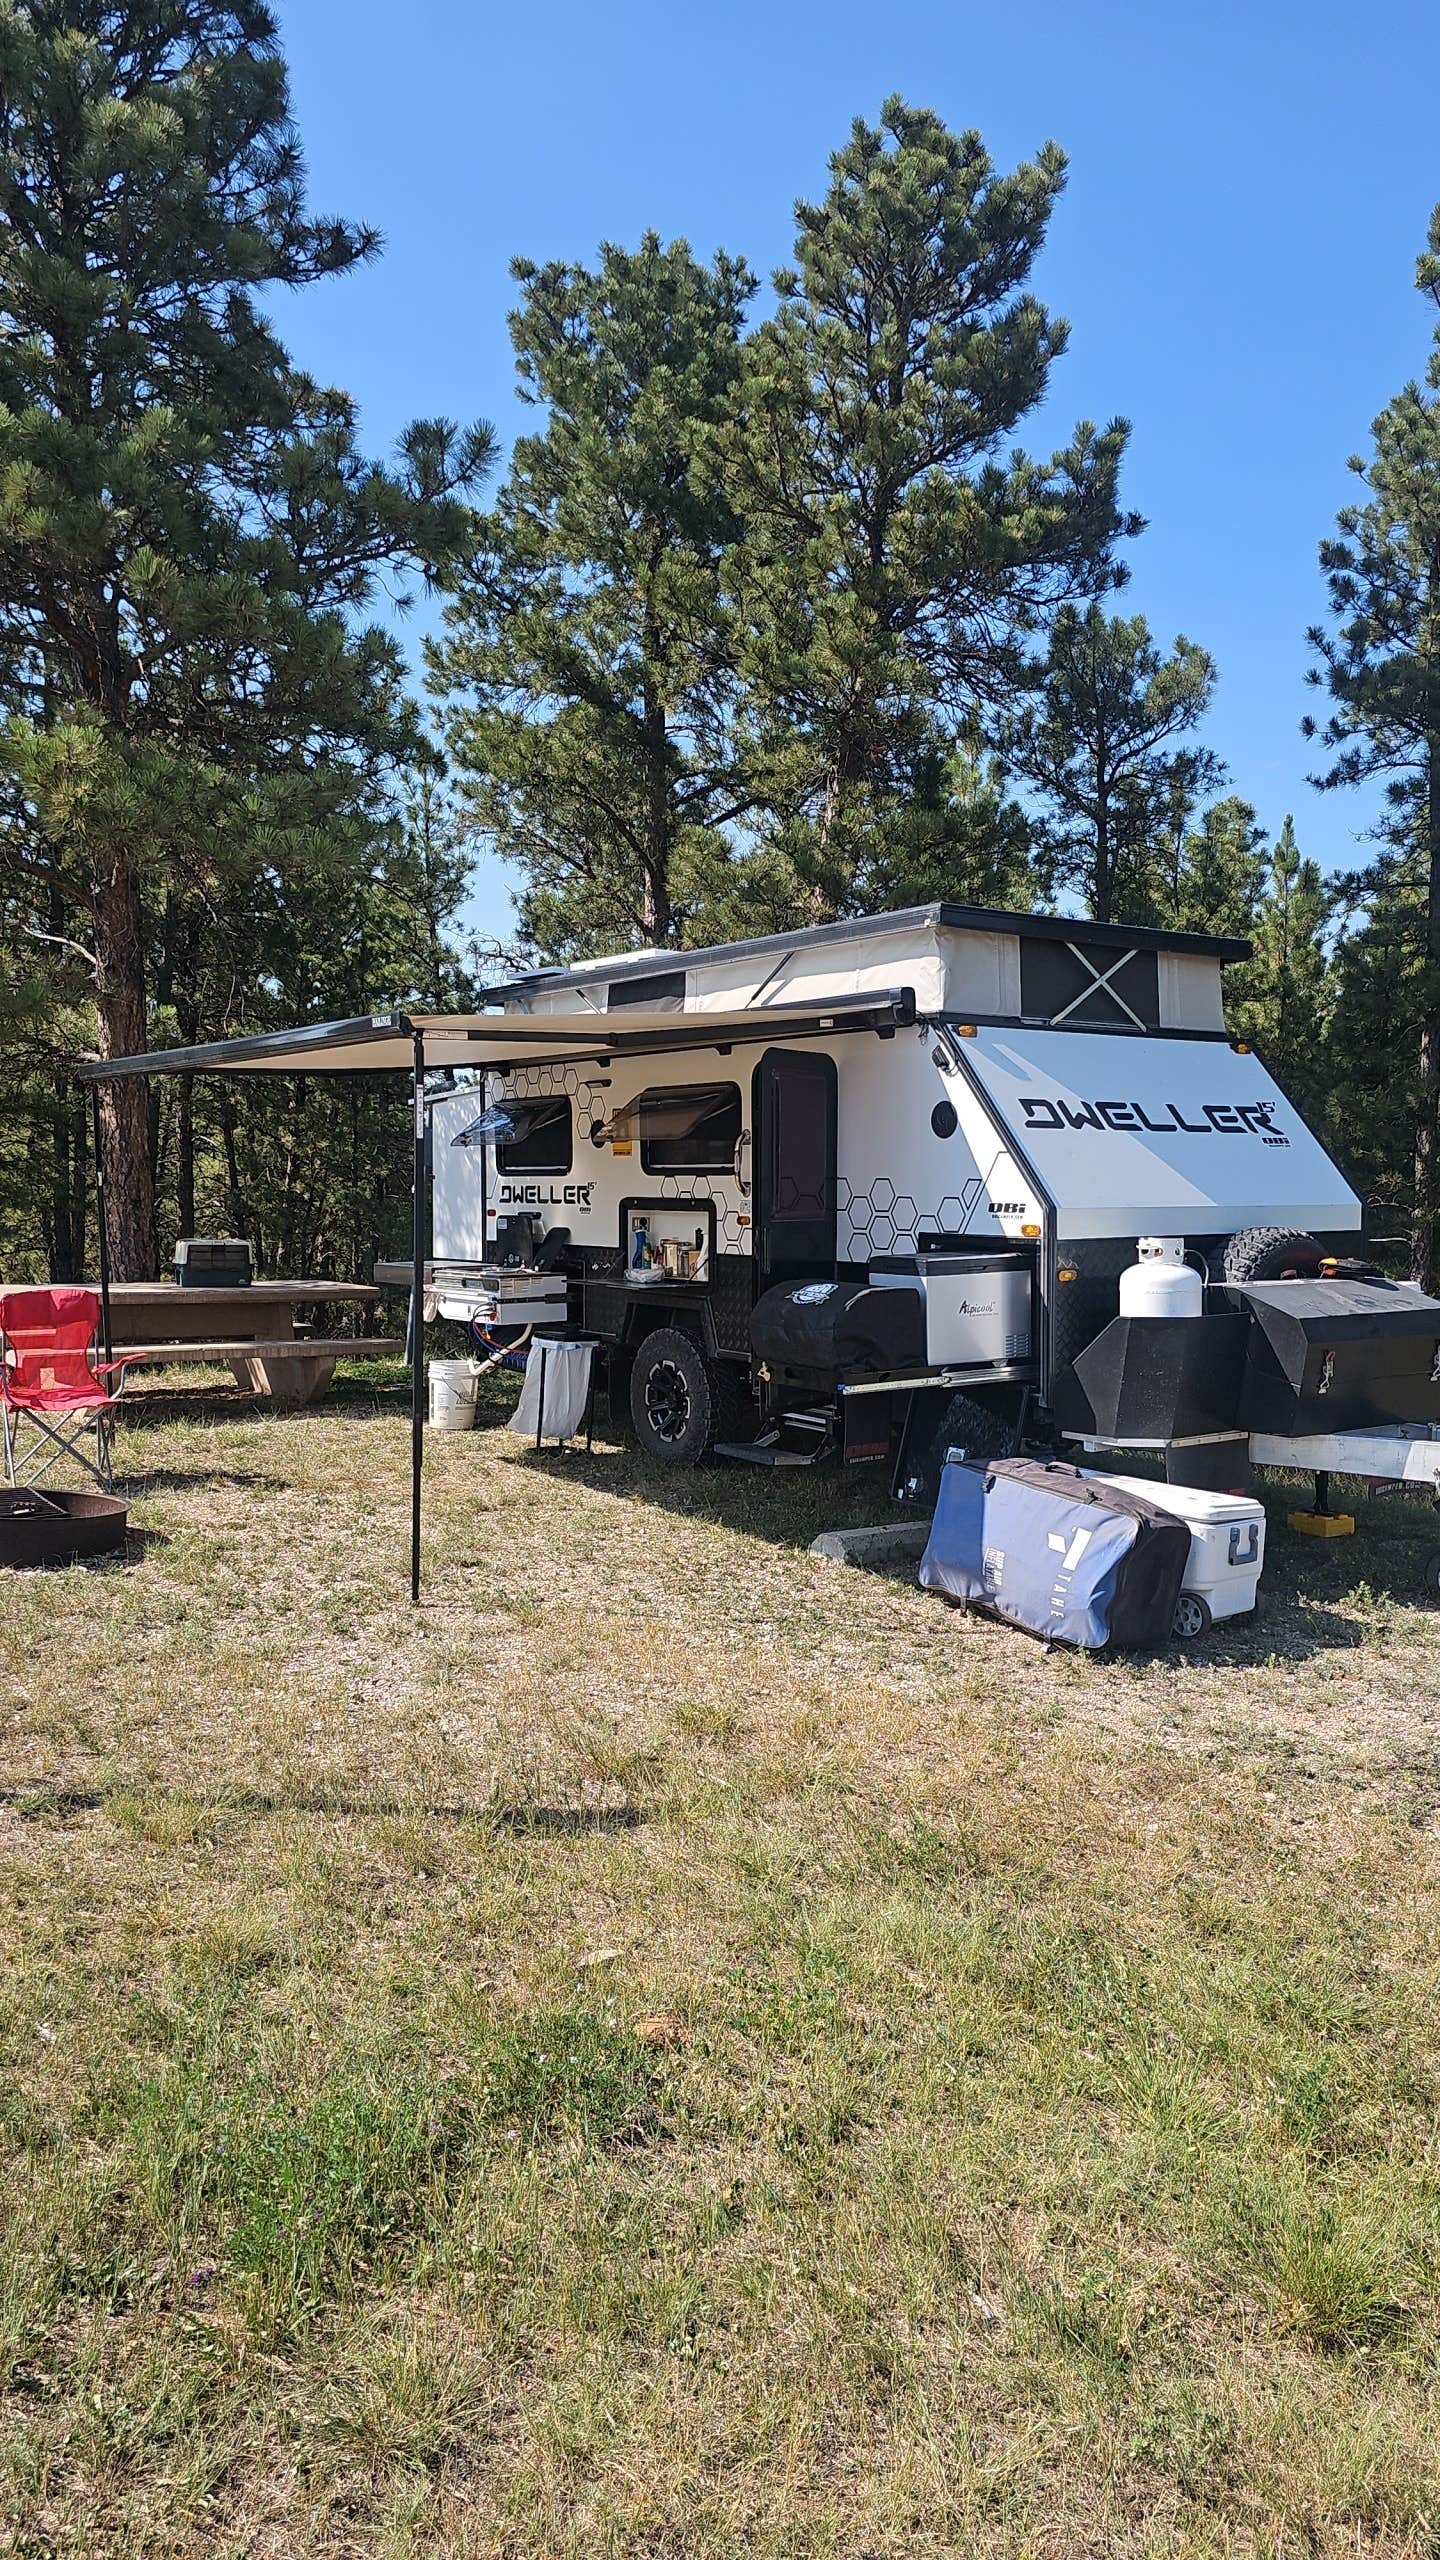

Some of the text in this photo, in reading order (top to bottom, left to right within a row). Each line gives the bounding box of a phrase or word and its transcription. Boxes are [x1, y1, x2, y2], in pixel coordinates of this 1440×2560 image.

[1017, 1098, 1285, 1136] DWELLER
[499, 1185, 592, 1206] DWELLER
[959, 1299, 993, 1317] Alpicool
[993, 1550, 1006, 1586] SUP AIR
[1050, 1574, 1072, 1618] TAHE
